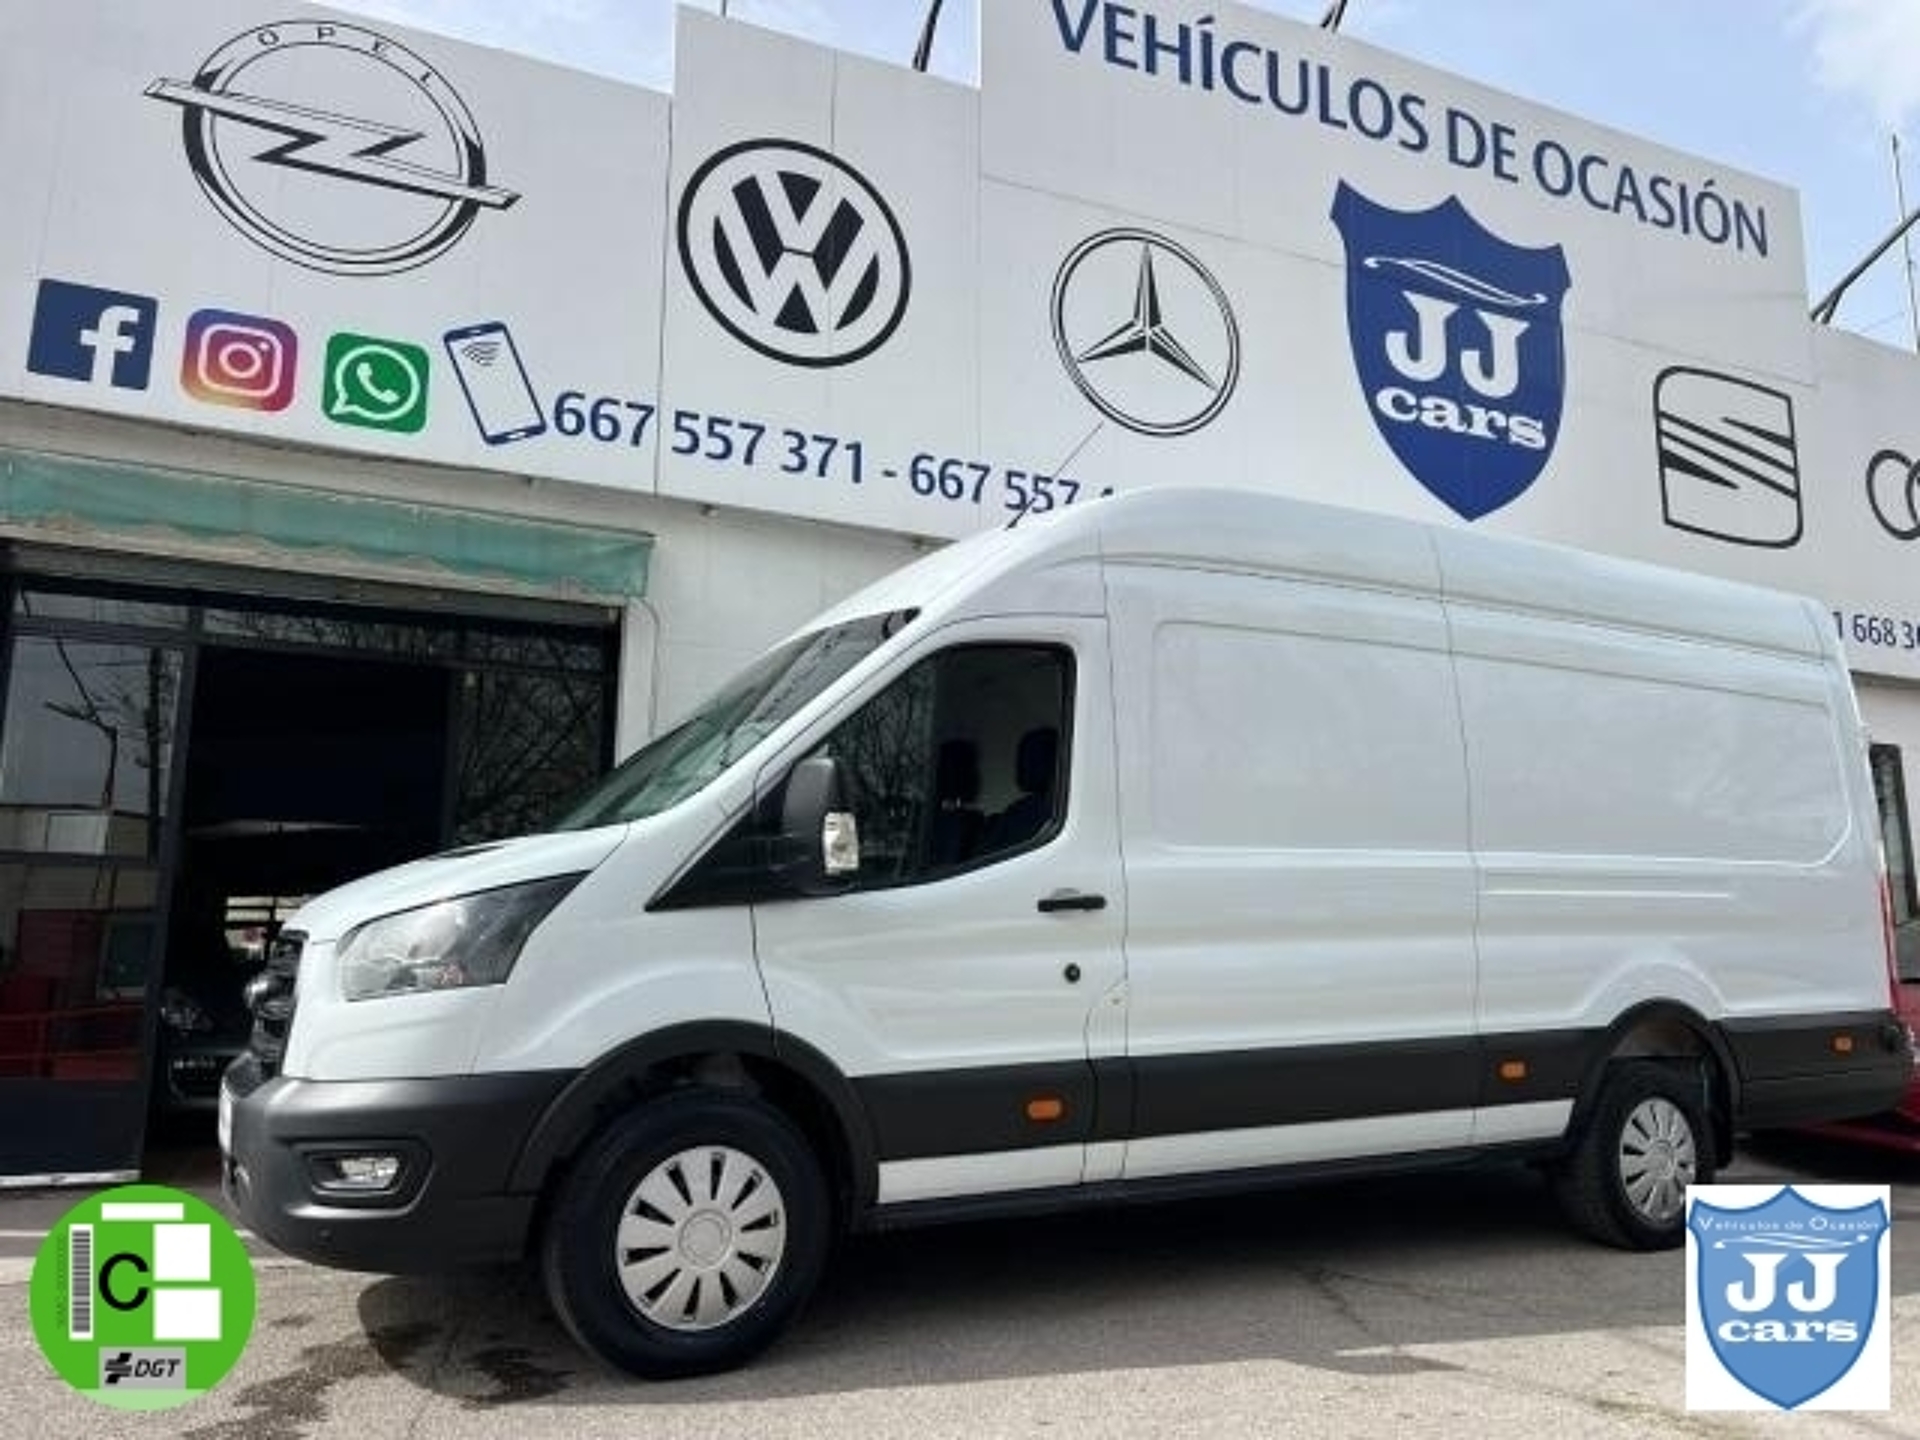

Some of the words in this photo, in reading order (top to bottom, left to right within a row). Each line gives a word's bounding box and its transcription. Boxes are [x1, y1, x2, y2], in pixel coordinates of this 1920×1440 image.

[1052, 0, 1429, 152] VEHÍCULOS
[1446, 108, 1519, 184] DE
[1532, 140, 1769, 258] OCASIÓN
[1385, 290, 1531, 399] JJ
[553, 391, 655, 447] 667
[671, 410, 766, 466] 557
[781, 429, 862, 484] 371
[910, 453, 991, 503] 667
[1004, 470, 1080, 513] 557
[1376, 387, 1546, 450] cars
[1853, 614, 1897, 646] 668
